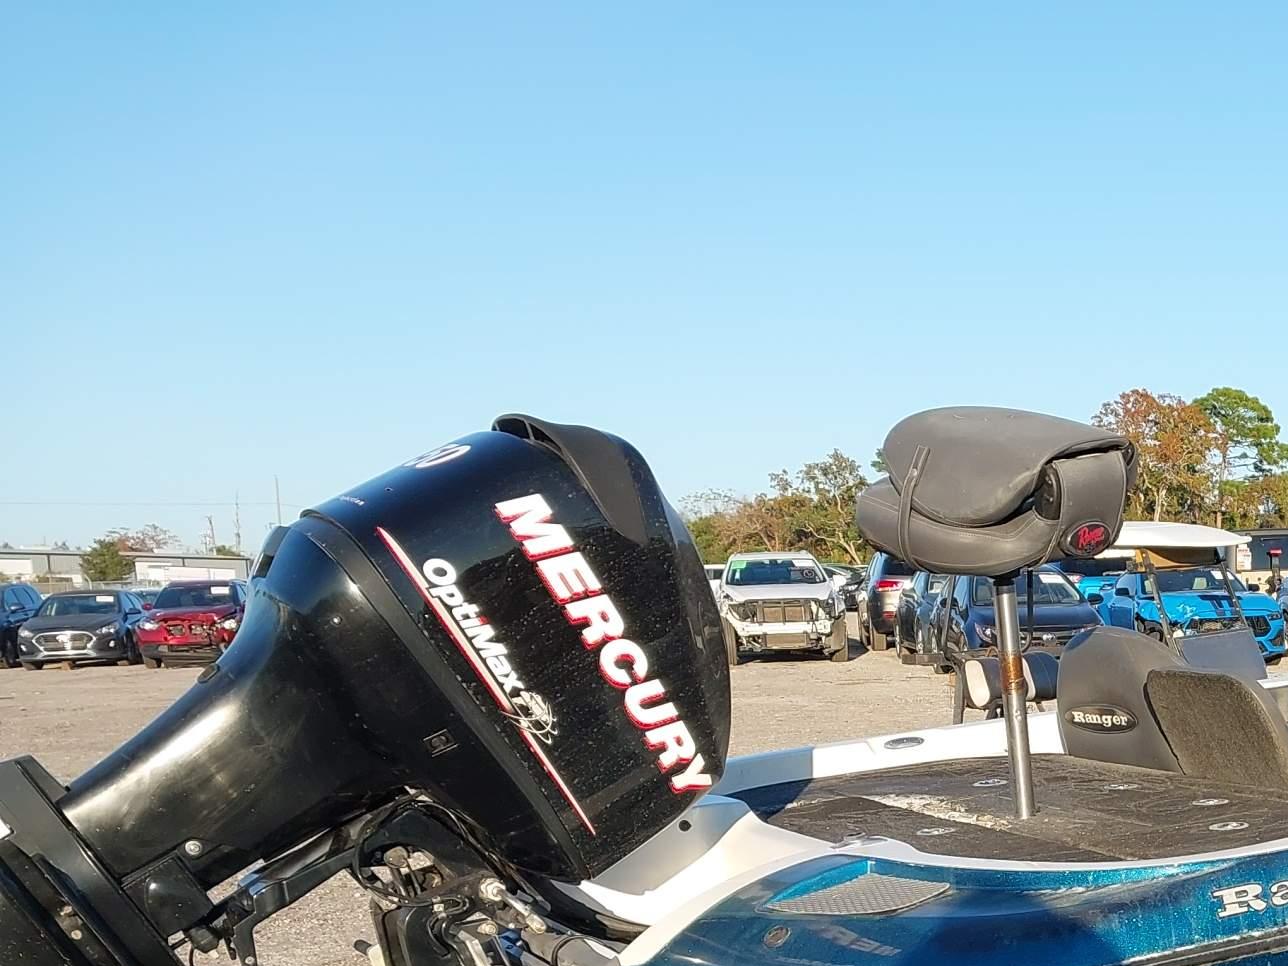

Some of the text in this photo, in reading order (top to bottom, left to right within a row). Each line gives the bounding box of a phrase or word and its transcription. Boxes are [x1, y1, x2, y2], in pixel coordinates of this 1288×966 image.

[423, 558, 524, 694] OptiMax
[494, 493, 712, 795] MERCURY
[1072, 710, 1128, 727] Ranger
